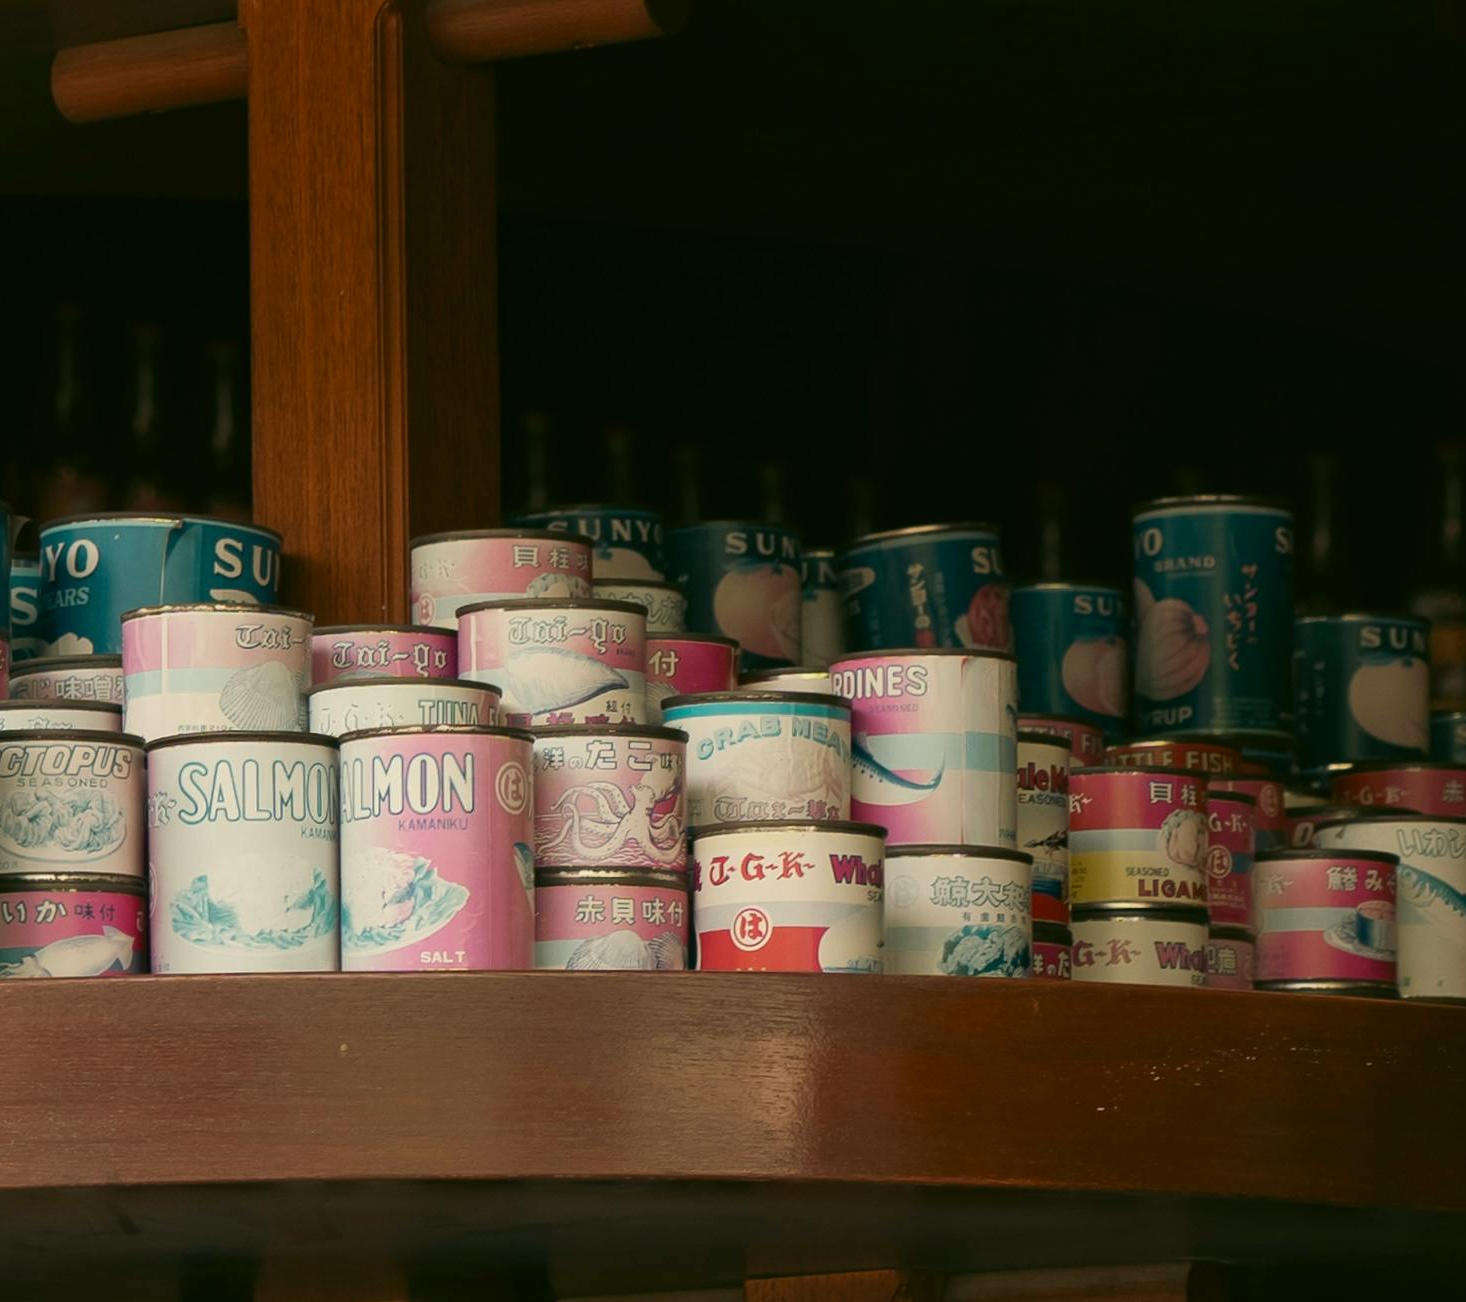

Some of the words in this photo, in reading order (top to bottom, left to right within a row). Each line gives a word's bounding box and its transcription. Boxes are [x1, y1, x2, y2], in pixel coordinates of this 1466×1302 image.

[697, 715, 782, 760] CRAB
[15, 777, 109, 789] SEASONED
[178, 759, 339, 825] SALMO
[398, 818, 469, 833] KAMANIKU
[1126, 866, 1169, 878] SEASONED
[2, 900, 69, 926] いか
[74, 904, 117, 921] 味付
[575, 895, 684, 927] 赤貝味付
[421, 951, 466, 964] SALT
